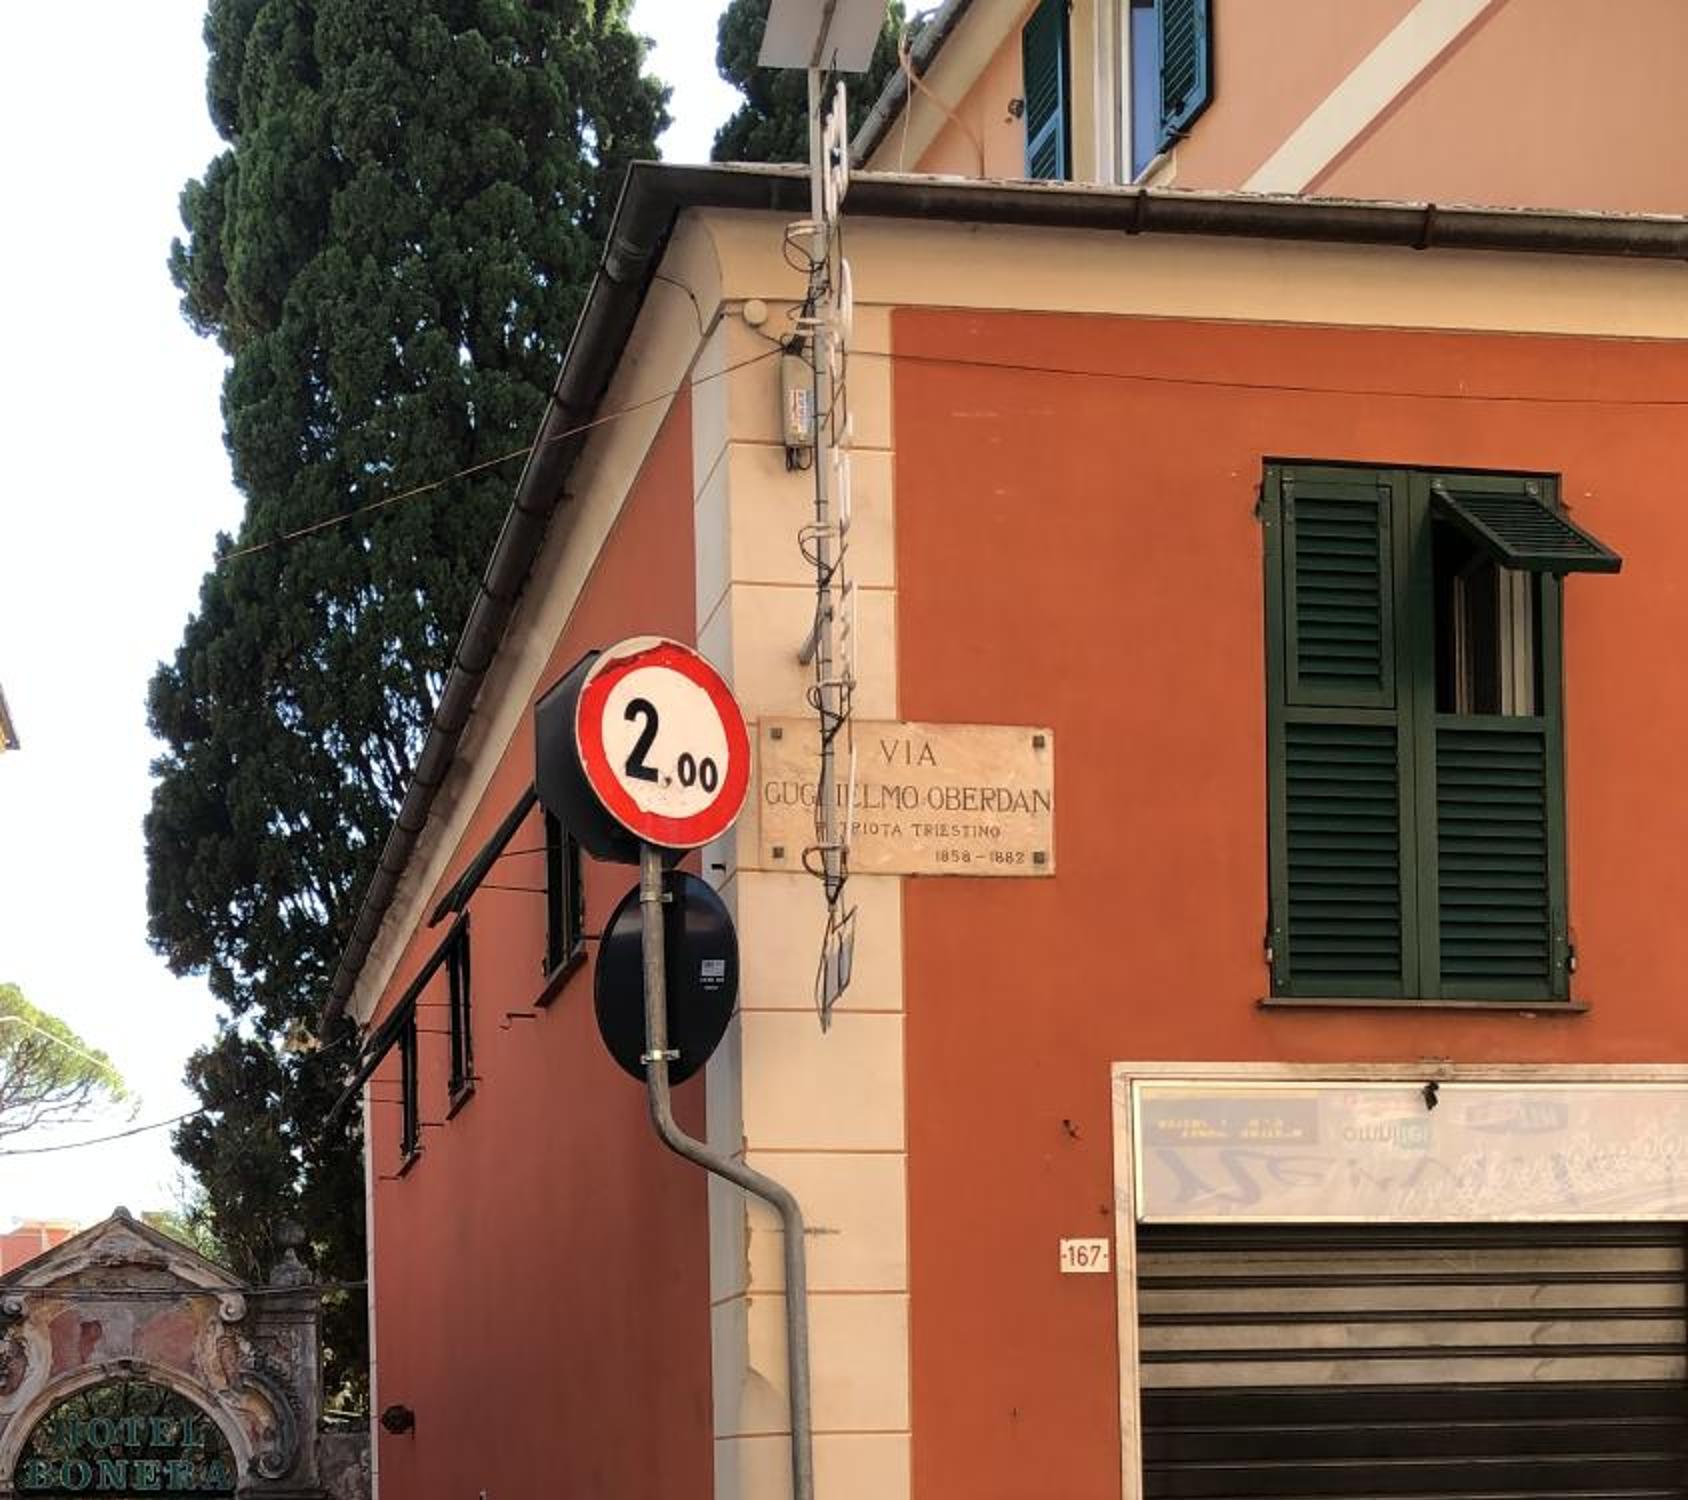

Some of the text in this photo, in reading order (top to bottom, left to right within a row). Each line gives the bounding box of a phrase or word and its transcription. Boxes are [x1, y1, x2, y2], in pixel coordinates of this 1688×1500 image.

[623, 697, 719, 793] 2,00
[880, 739, 937, 767] VIA
[764, 781, 1051, 814] GUGIELMO OBERDAN
[911, 823, 1001, 839] TRIESTINO
[1067, 1244, 1102, 1268] 167
[54, 1415, 205, 1448] HOTEL
[23, 1456, 232, 1492] BONERA
